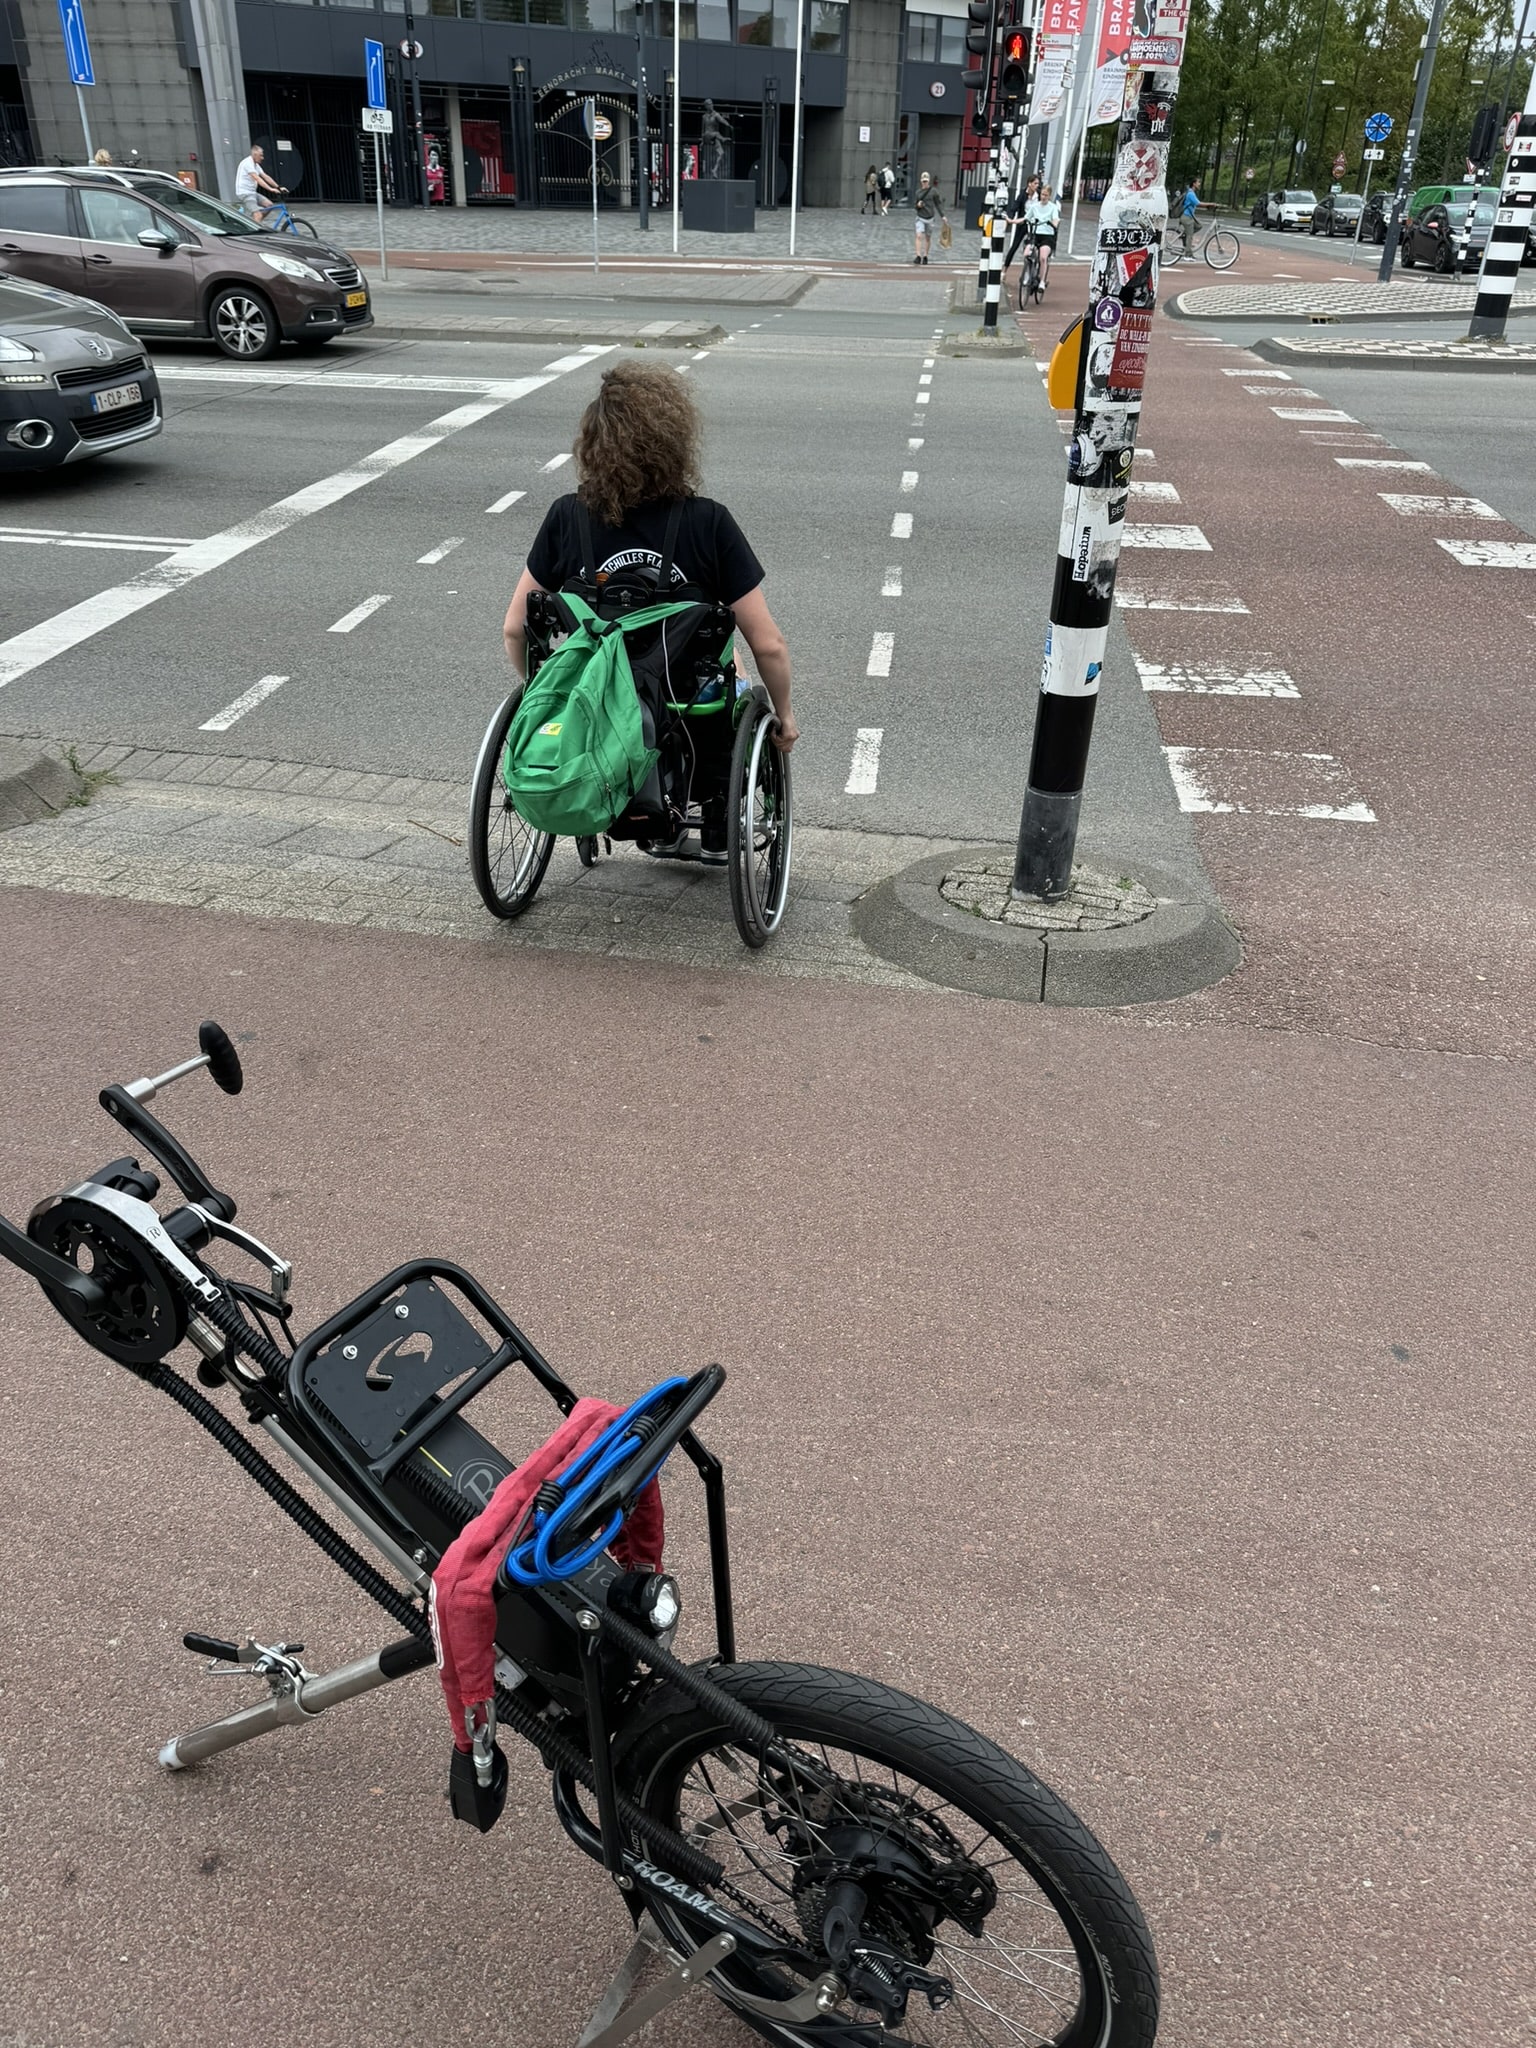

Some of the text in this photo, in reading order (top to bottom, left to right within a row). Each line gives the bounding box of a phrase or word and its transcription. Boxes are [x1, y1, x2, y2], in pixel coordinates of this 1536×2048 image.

[1050, 0, 1064, 28] BR
[538, 66, 587, 99] EENDRACHT
[595, 66, 625, 81] MAAKT
[604, 552, 644, 576] ACHILLES
[633, 1860, 717, 1913] ROAM
